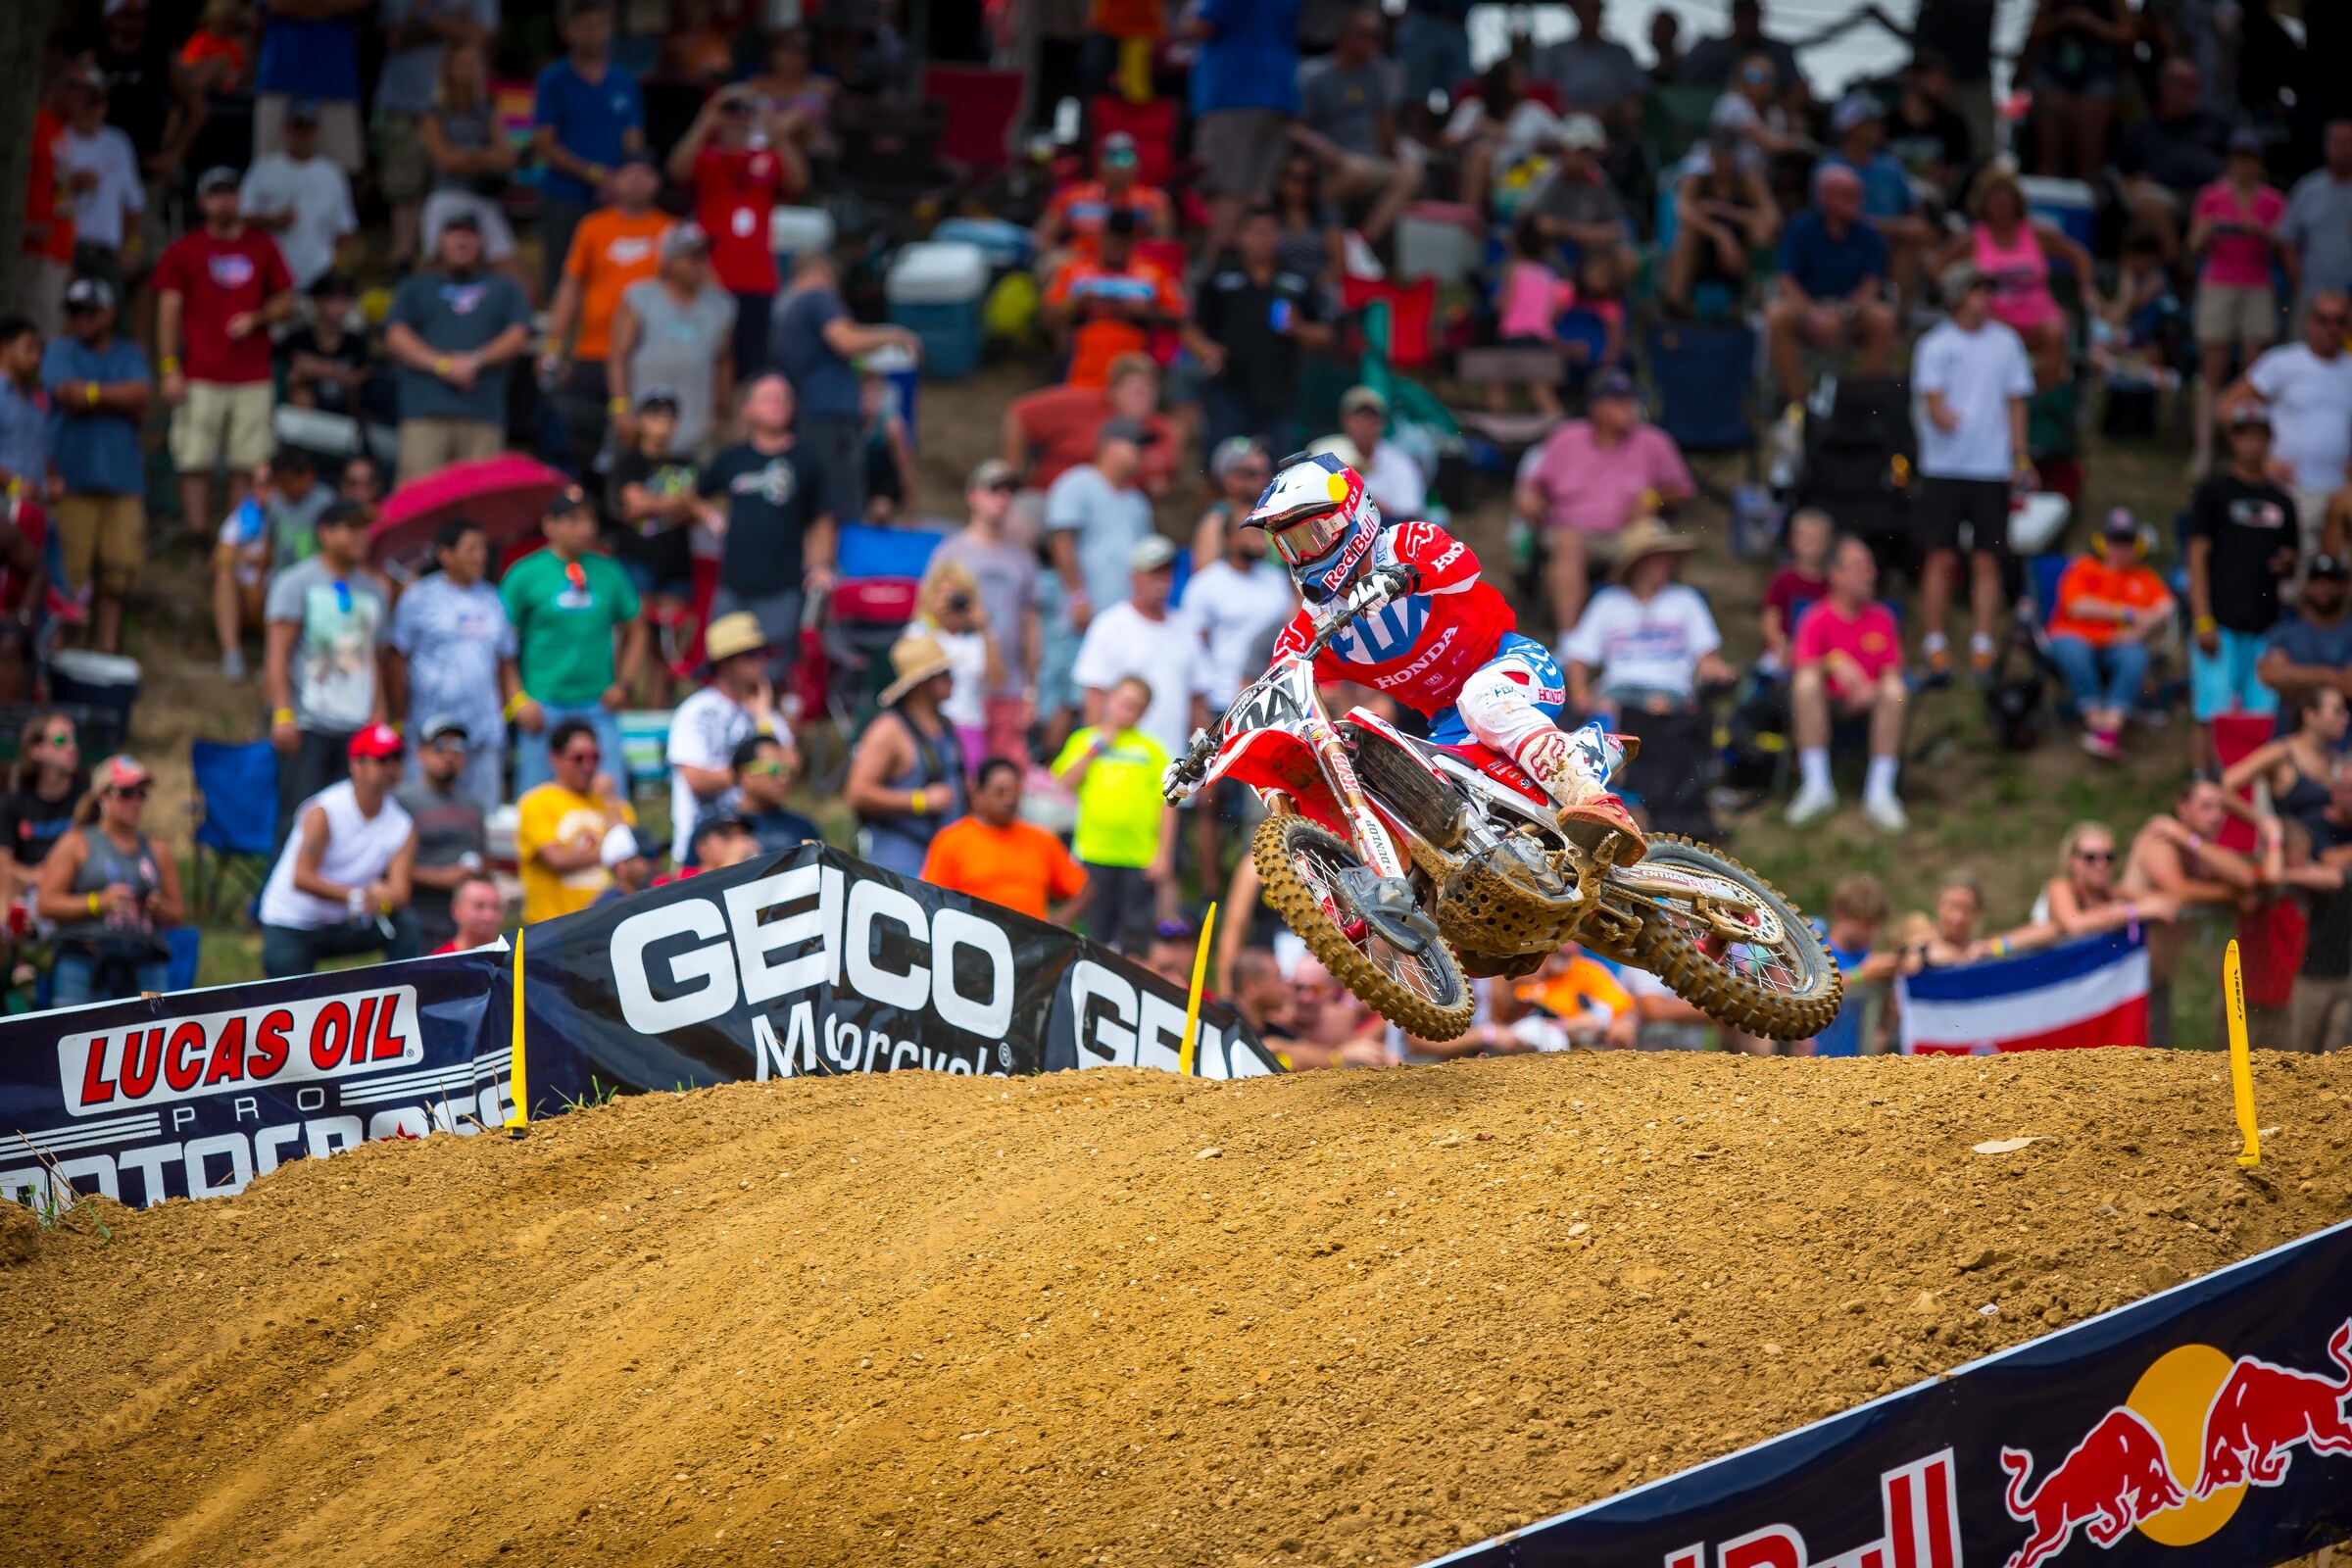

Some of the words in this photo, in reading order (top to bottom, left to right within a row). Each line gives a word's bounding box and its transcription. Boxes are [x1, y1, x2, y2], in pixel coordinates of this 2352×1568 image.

[1345, 485, 1359, 513] FOX
[1322, 546, 1359, 592] Red
[1350, 514, 1378, 557] Bull
[1374, 625, 1459, 690] HONDA
[1331, 753, 1362, 792] KYB
[1365, 819, 1392, 865] DUNLOP
[610, 863, 1014, 1039] GEICO
[80, 1008, 295, 1106] LUCAS
[309, 994, 407, 1071] OIL
[172, 1086, 326, 1133] PRO
